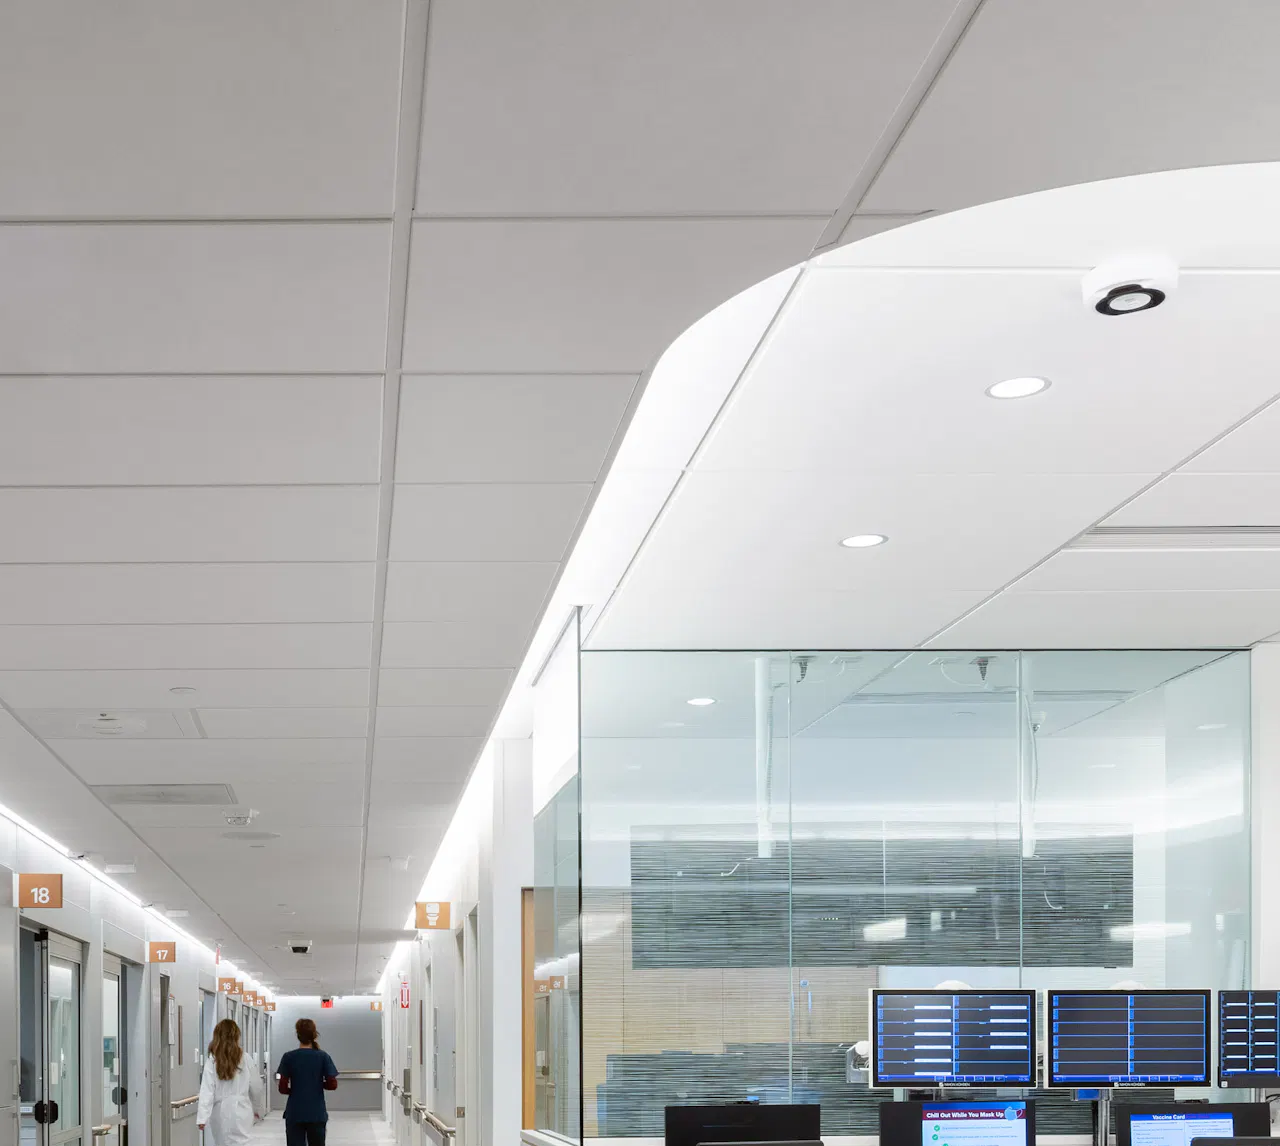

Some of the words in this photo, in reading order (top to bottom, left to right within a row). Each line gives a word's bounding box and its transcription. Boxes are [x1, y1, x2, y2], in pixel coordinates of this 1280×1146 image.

[30, 887, 50, 904] 18
[156, 949, 169, 960] 17
[222, 982, 231, 990] 16
